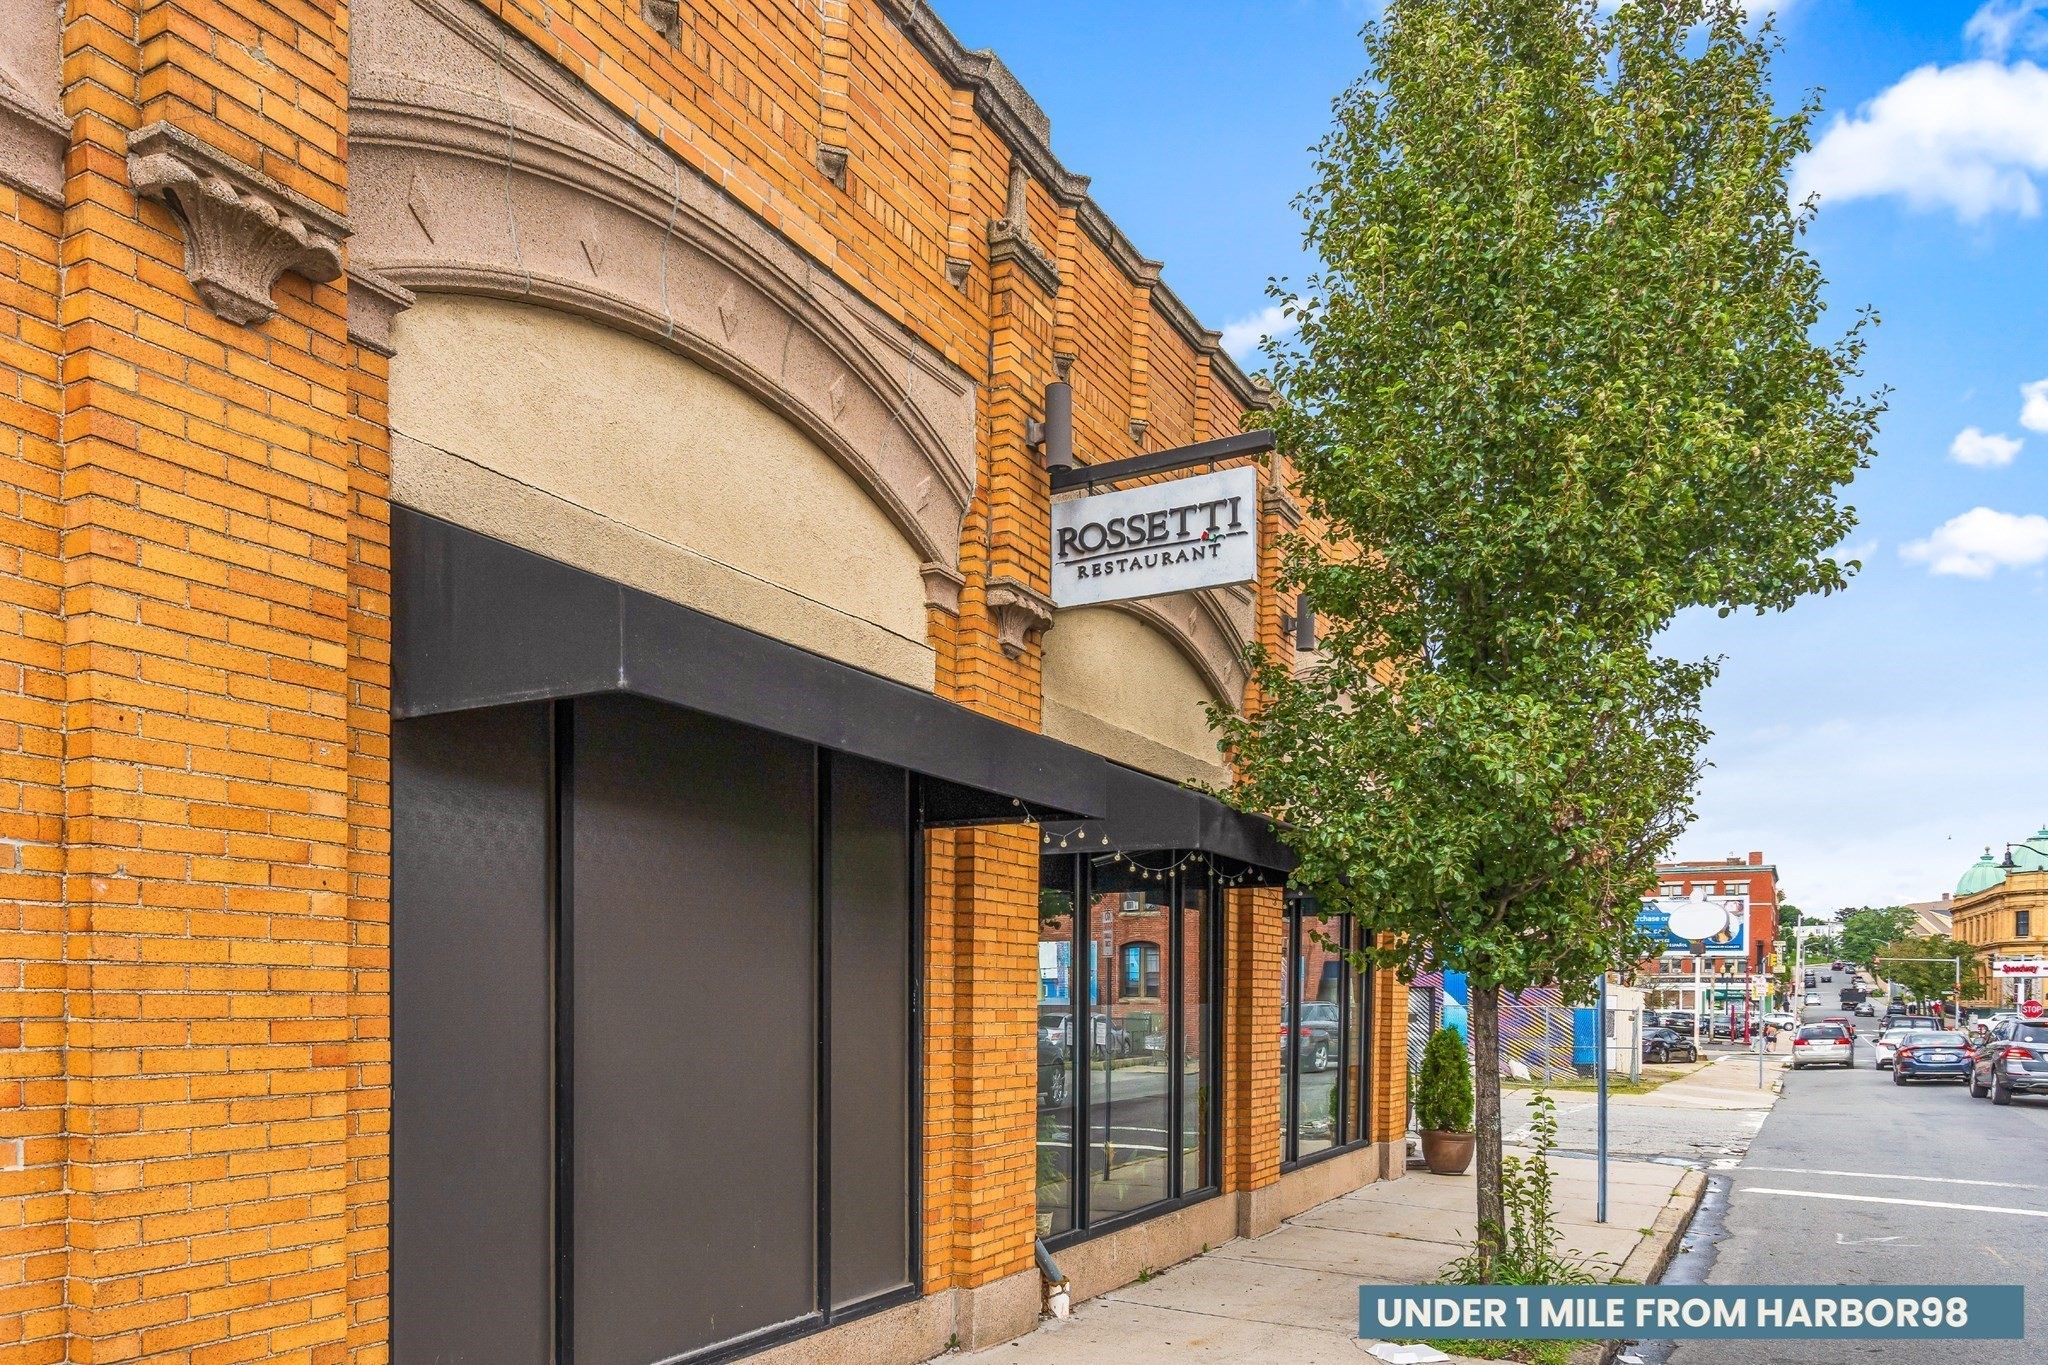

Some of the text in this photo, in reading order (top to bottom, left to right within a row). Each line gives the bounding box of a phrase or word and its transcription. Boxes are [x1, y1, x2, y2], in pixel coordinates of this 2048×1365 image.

[1057, 495, 1242, 558] ROSSETTI
[1077, 543, 1221, 579] RESTAURANT
[2002, 964, 2039, 974] Speedway
[2022, 1005, 2042, 1014] STOP
